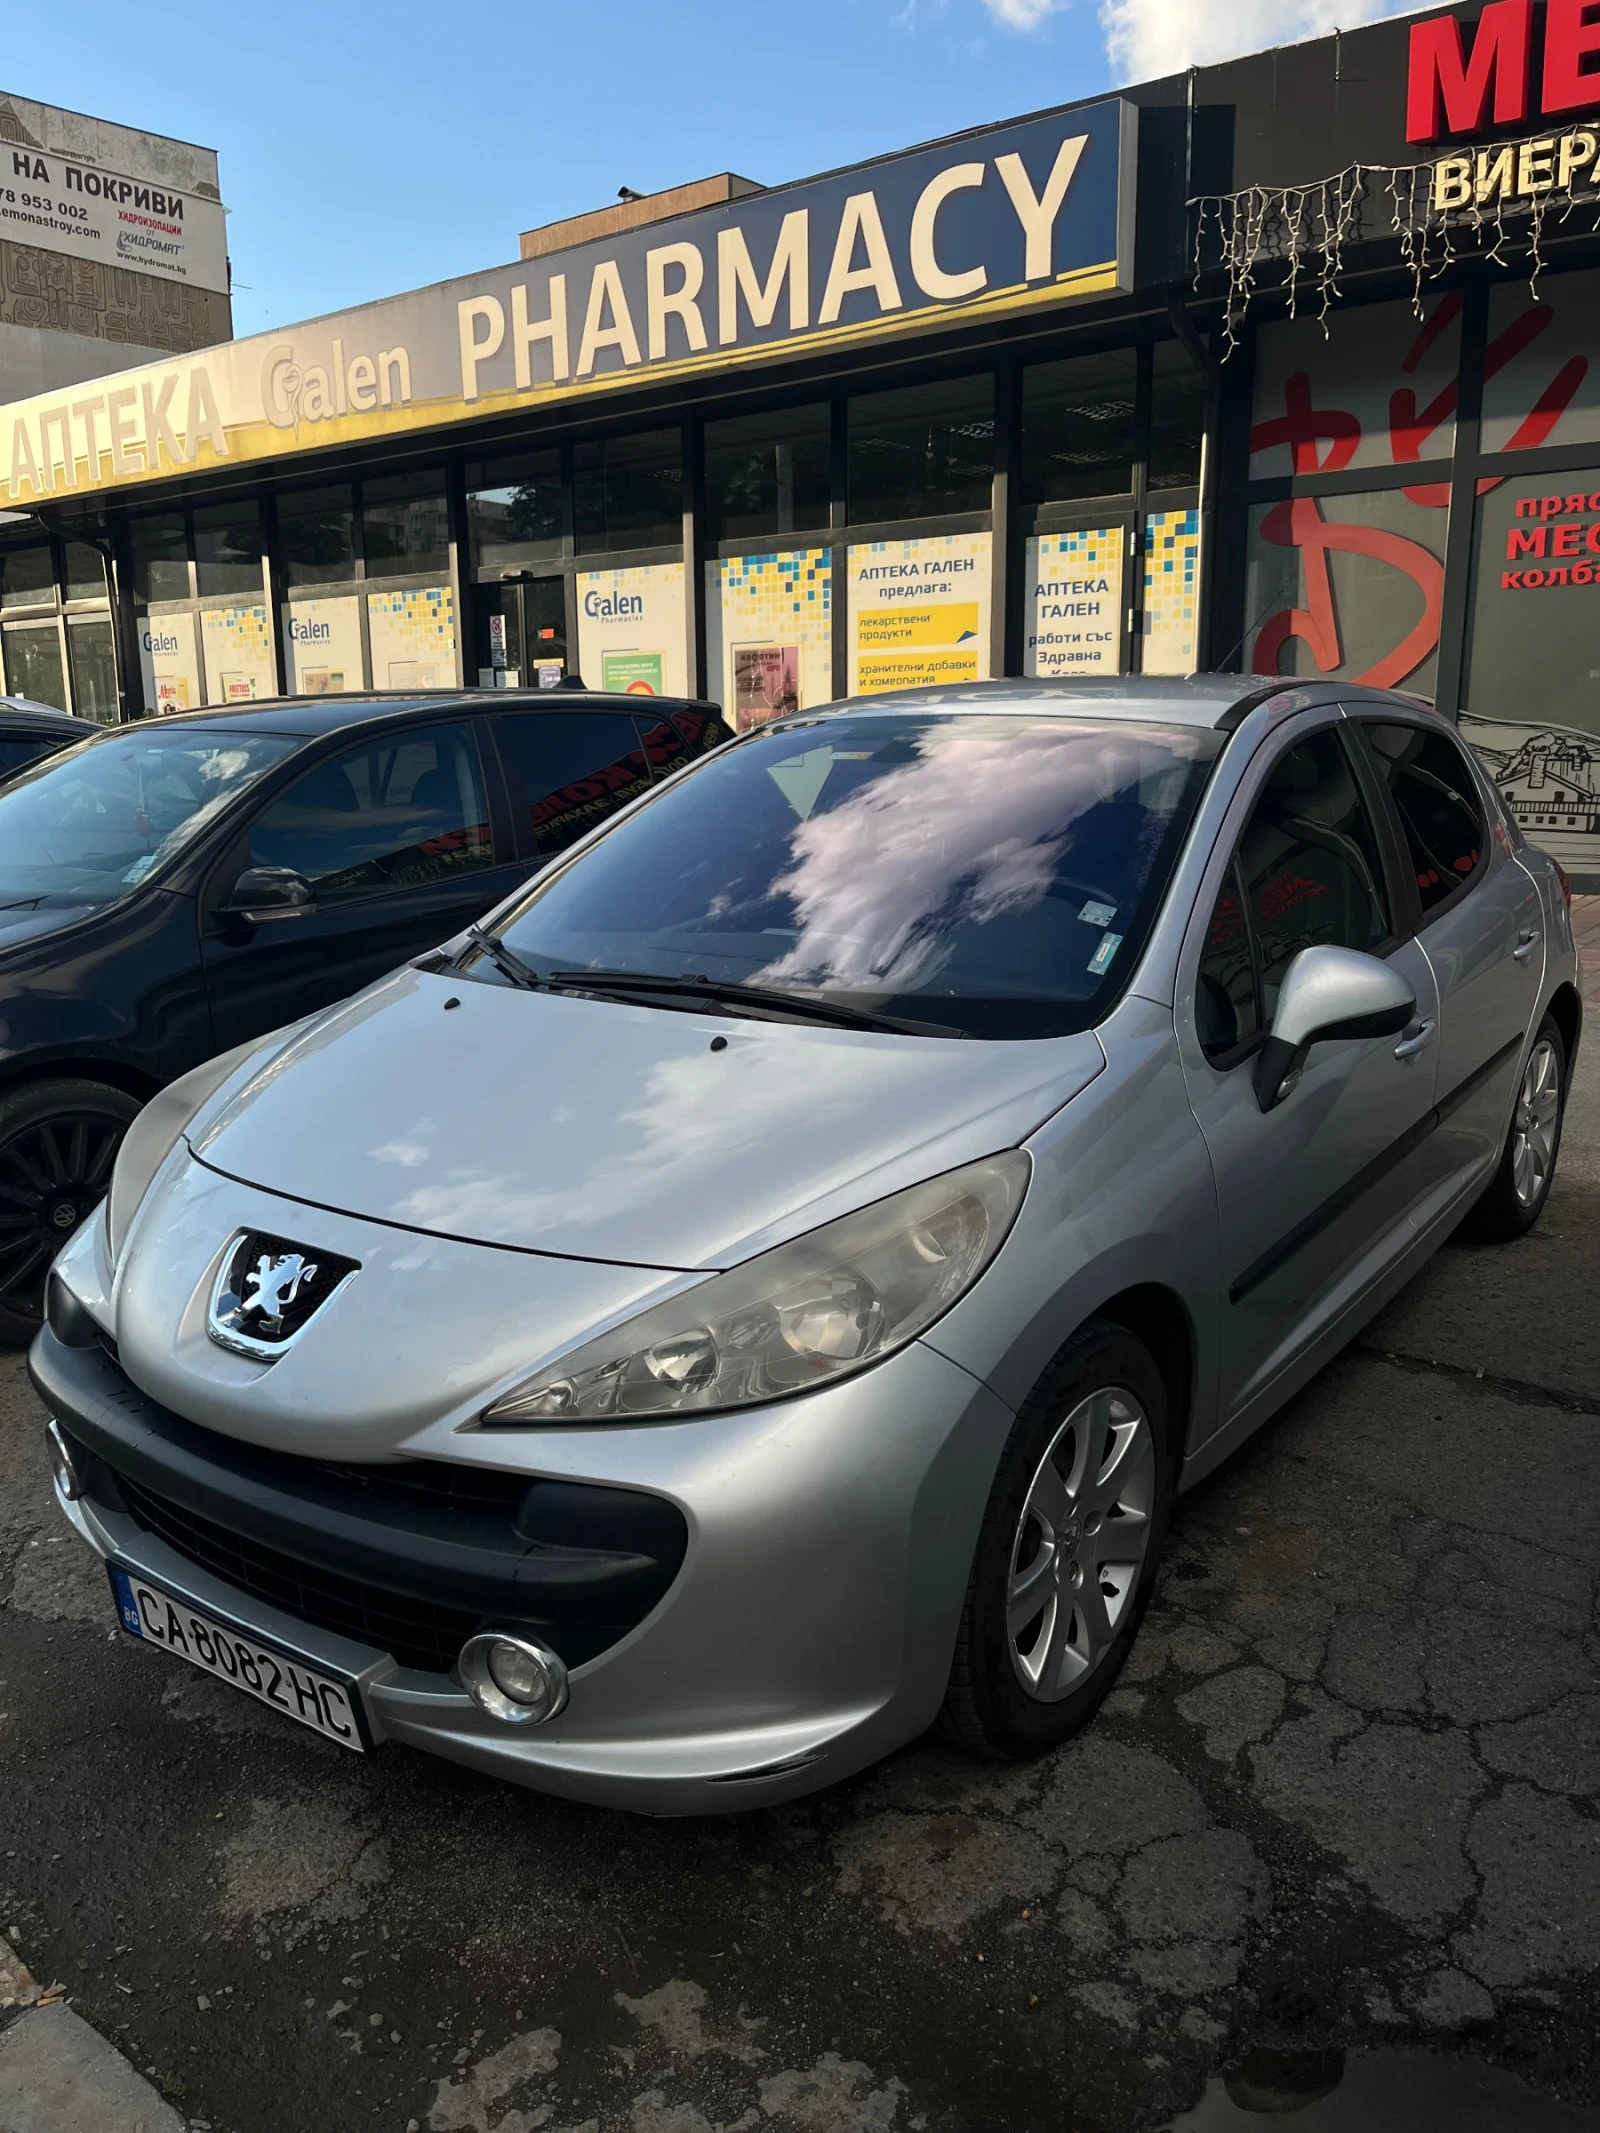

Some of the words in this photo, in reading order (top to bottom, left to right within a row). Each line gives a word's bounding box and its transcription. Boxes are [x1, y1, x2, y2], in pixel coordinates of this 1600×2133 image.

[1435, 132, 1600, 210] ВИЕР
[13, 152, 50, 184] НА
[65, 166, 184, 220] ПОКРИВИ
[21, 193, 52, 211] 953
[58, 202, 88, 221] 002
[0, 208, 101, 239] emonastroy.com
[117, 210, 182, 236] ХИДРОИЗОЛАЦИИ
[123, 231, 181, 255] ХИДРОМАТ
[117, 251, 187, 275] www.hydromat.bg
[456, 133, 1090, 402] PHARMACY
[261, 338, 412, 438] Galen
[8, 366, 230, 498] АПТЕКА
[859, 563, 920, 580] АПТЕКА
[924, 558, 975, 575] ГАЛЕН
[879, 582, 952, 600] предлага:
[1034, 579, 1109, 597] АПТЕКА
[584, 590, 643, 618] Galen
[1042, 602, 1100, 618] ГАЛЕН
[288, 618, 330, 641] Galen
[601, 615, 643, 624] Pharmacies
[860, 615, 931, 628] лекарствени
[143, 631, 178, 652] Galen
[860, 629, 912, 642] продукти
[1028, 633, 1081, 649] работи
[1086, 632, 1112, 642] със
[860, 663, 924, 675] хранителни
[927, 660, 976, 672] добавки
[1038, 651, 1101, 665] Здравна
[860, 679, 866, 687] и
[869, 675, 935, 686] хомеопатия
[124, 1605, 139, 1626] BG
